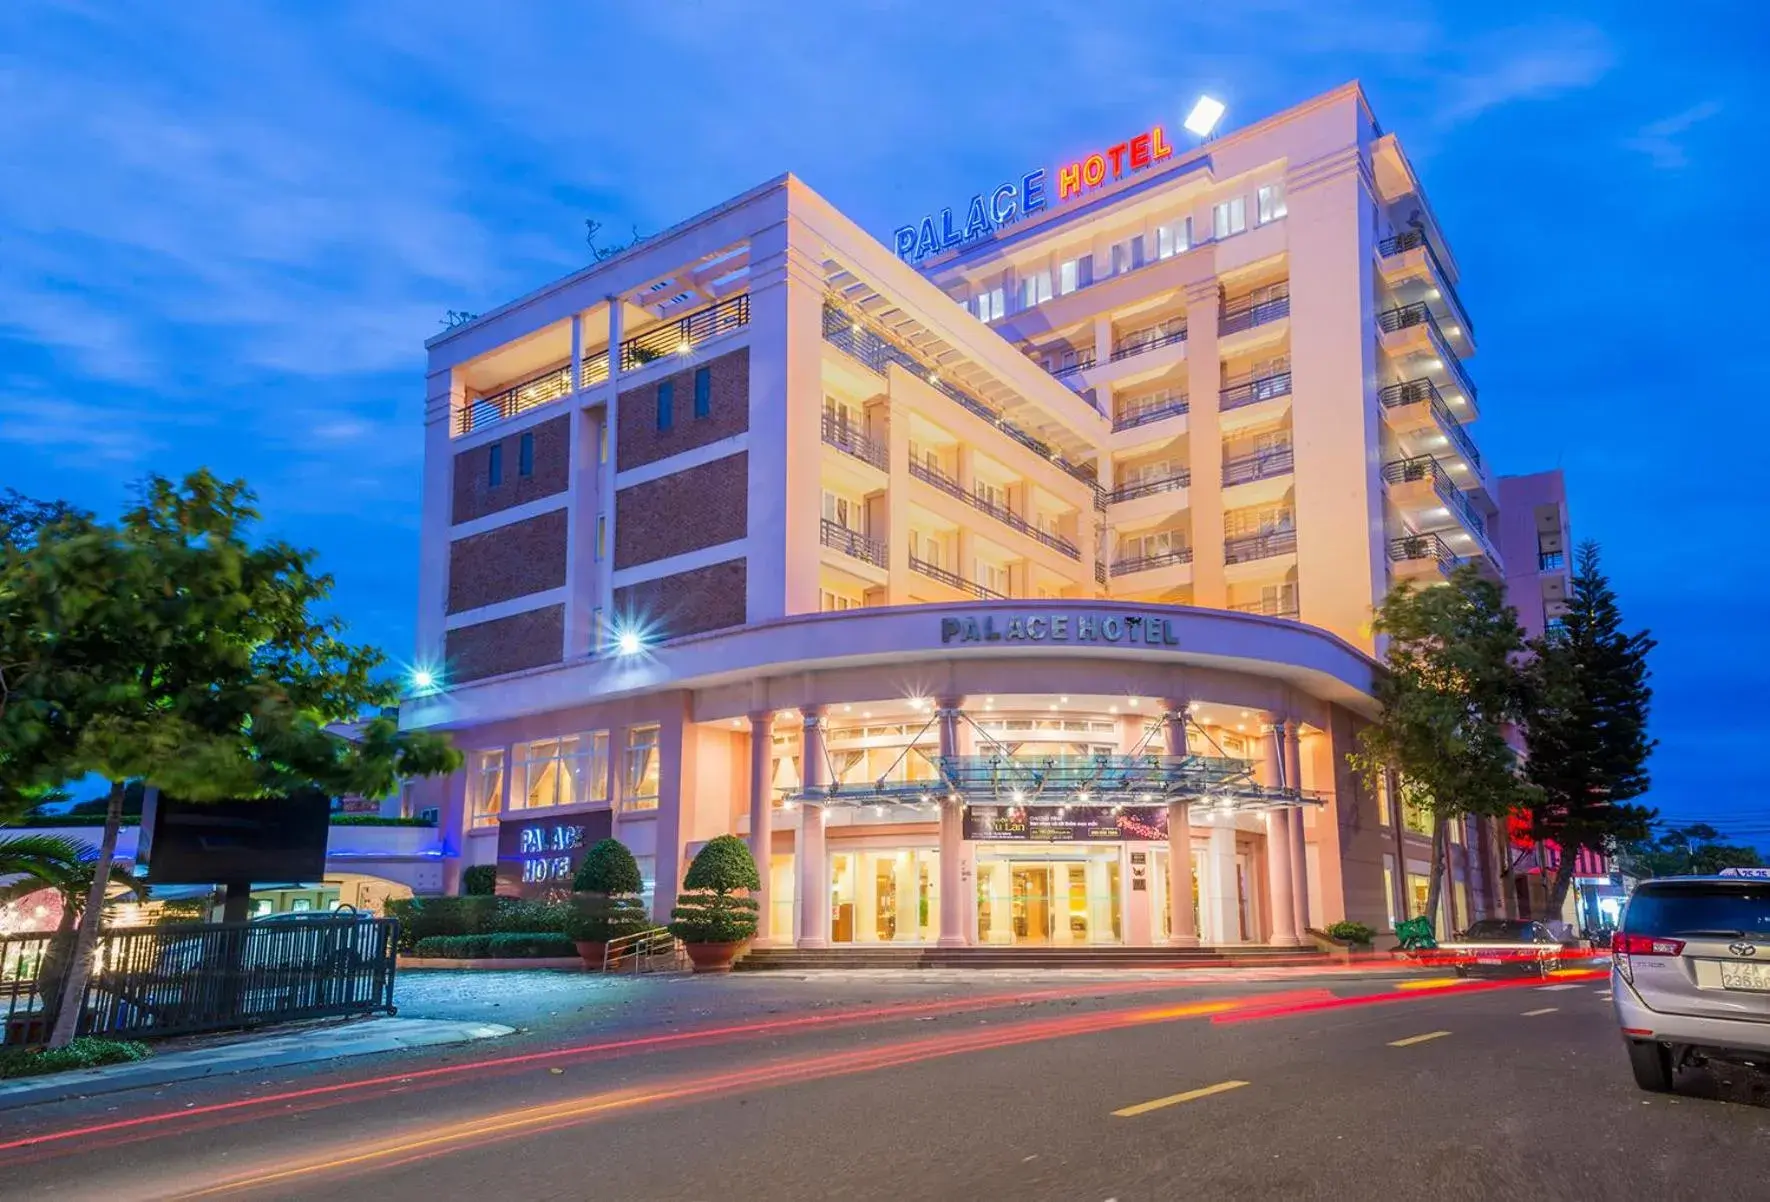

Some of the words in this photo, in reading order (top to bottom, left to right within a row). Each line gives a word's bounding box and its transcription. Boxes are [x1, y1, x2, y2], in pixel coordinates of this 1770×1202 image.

[894, 168, 1045, 260] PALACE
[1059, 127, 1172, 199] HOTEL
[941, 615, 1069, 644] PALACE
[1078, 615, 1180, 646] HOTEL
